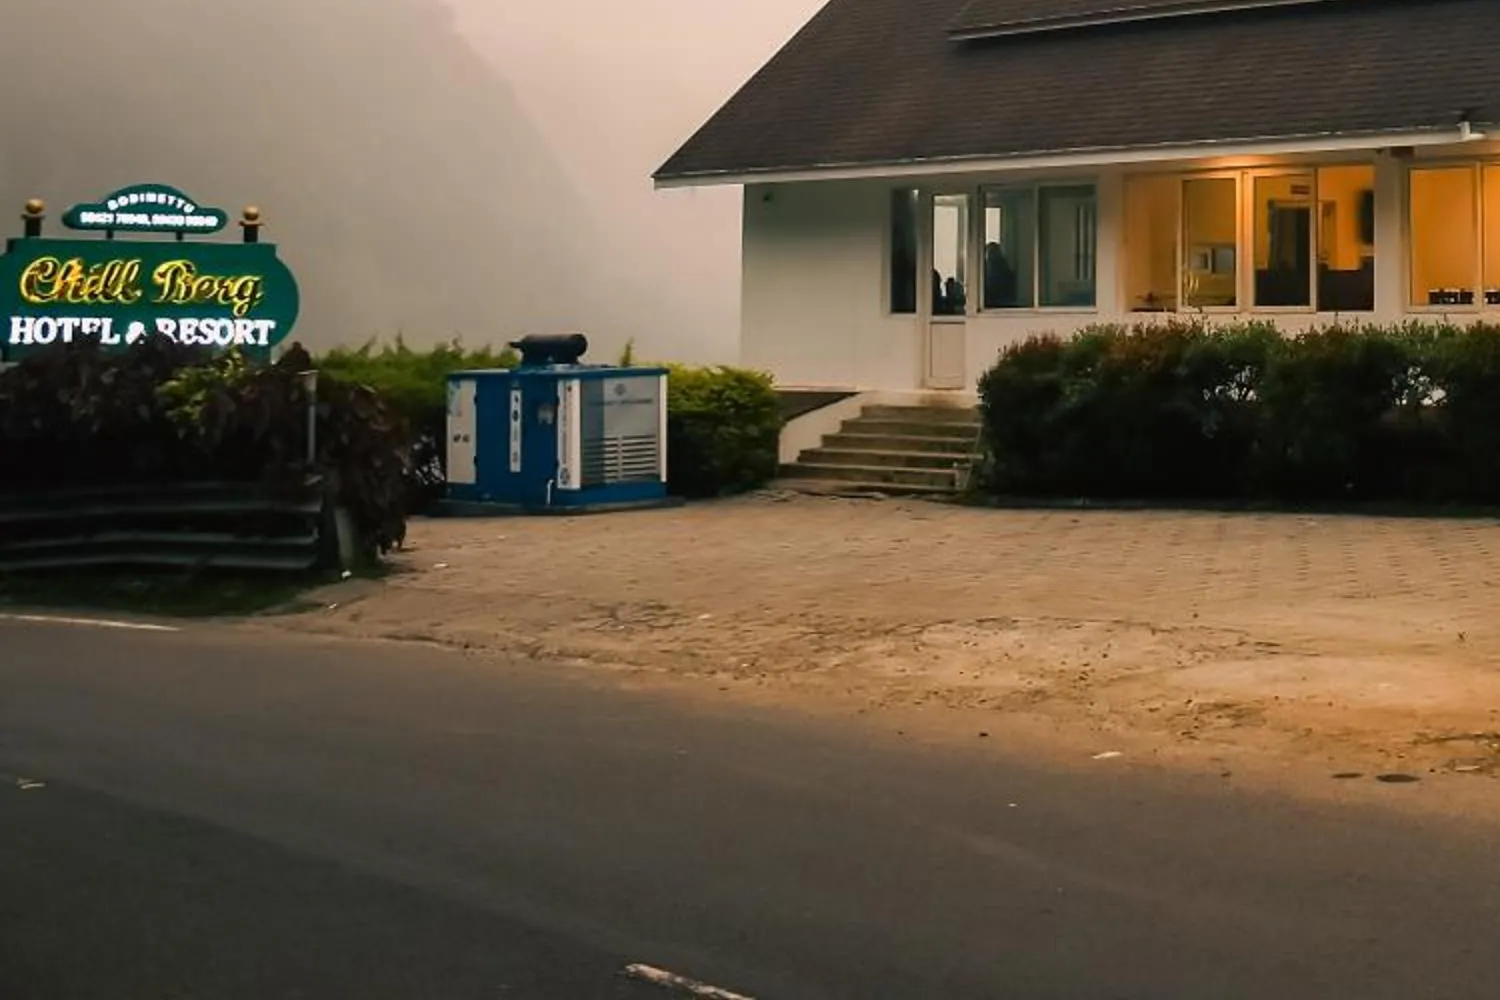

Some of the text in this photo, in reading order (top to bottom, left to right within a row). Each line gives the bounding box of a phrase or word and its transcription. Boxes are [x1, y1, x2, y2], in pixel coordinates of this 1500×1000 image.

[20, 257, 263, 316] Chill Berg
[155, 317, 276, 345] RESORT
